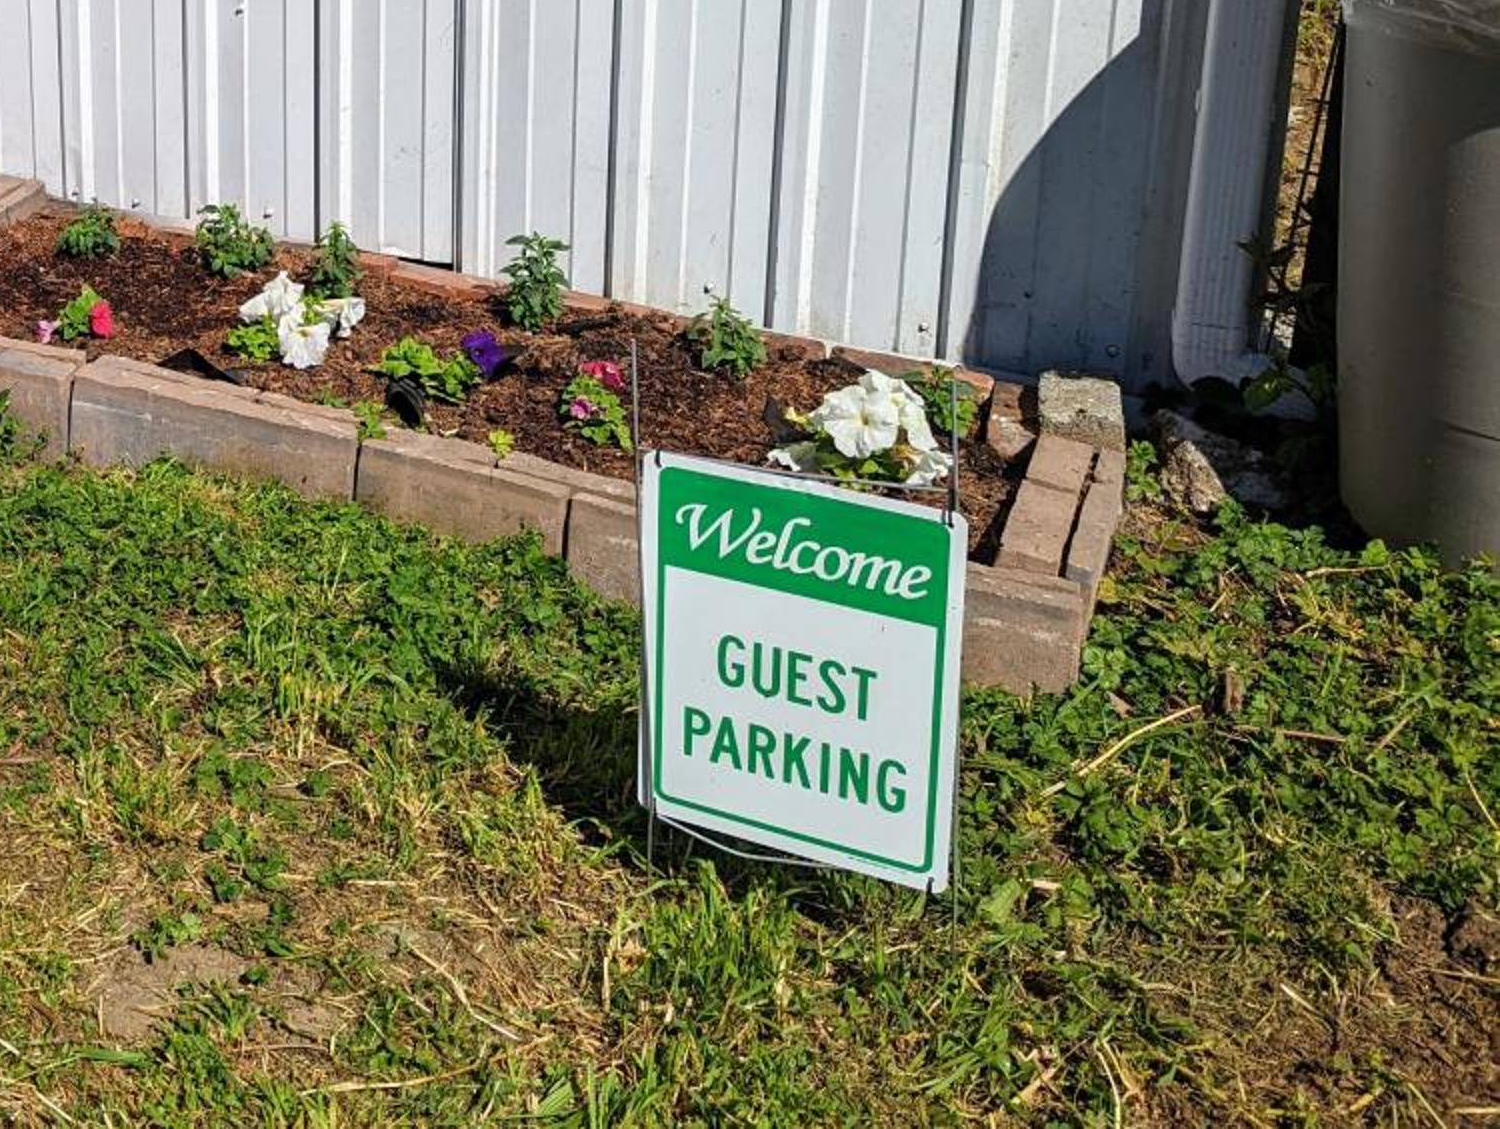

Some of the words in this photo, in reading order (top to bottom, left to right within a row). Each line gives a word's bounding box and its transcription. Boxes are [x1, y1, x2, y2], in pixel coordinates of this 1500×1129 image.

[676, 504, 932, 599] Welcome
[717, 635, 877, 720] GUEST
[683, 708, 907, 813] PARKING
